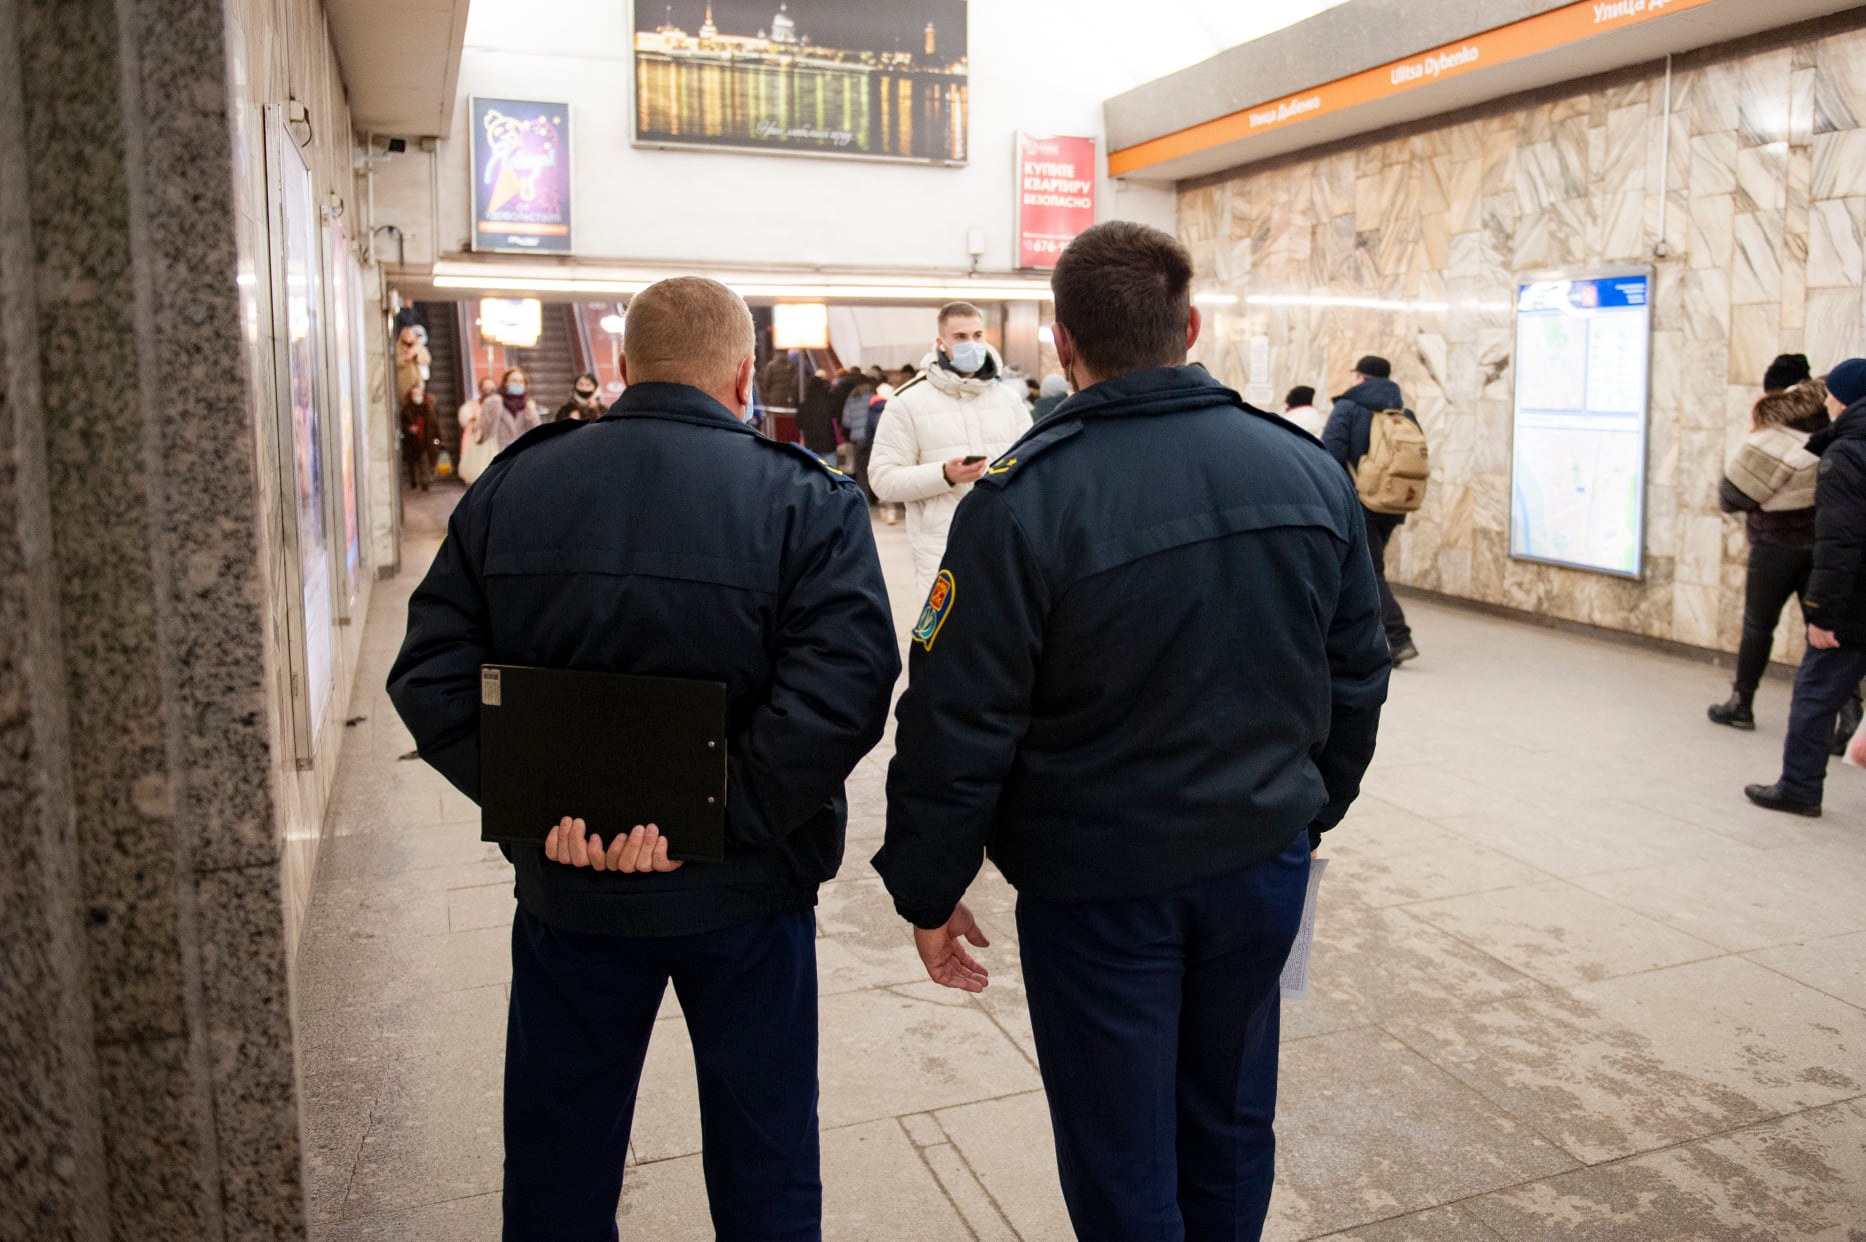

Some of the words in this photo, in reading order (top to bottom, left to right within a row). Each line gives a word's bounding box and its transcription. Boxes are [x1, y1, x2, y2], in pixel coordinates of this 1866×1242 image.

[1390, 64, 1423, 85] Ulitsa
[1425, 46, 1479, 77] Dybenko
[1024, 162, 1074, 178] КУПИТЕ
[1024, 177, 1091, 194] КВАРТИРУ
[1023, 194, 1092, 209] БЕЗОПАСНО
